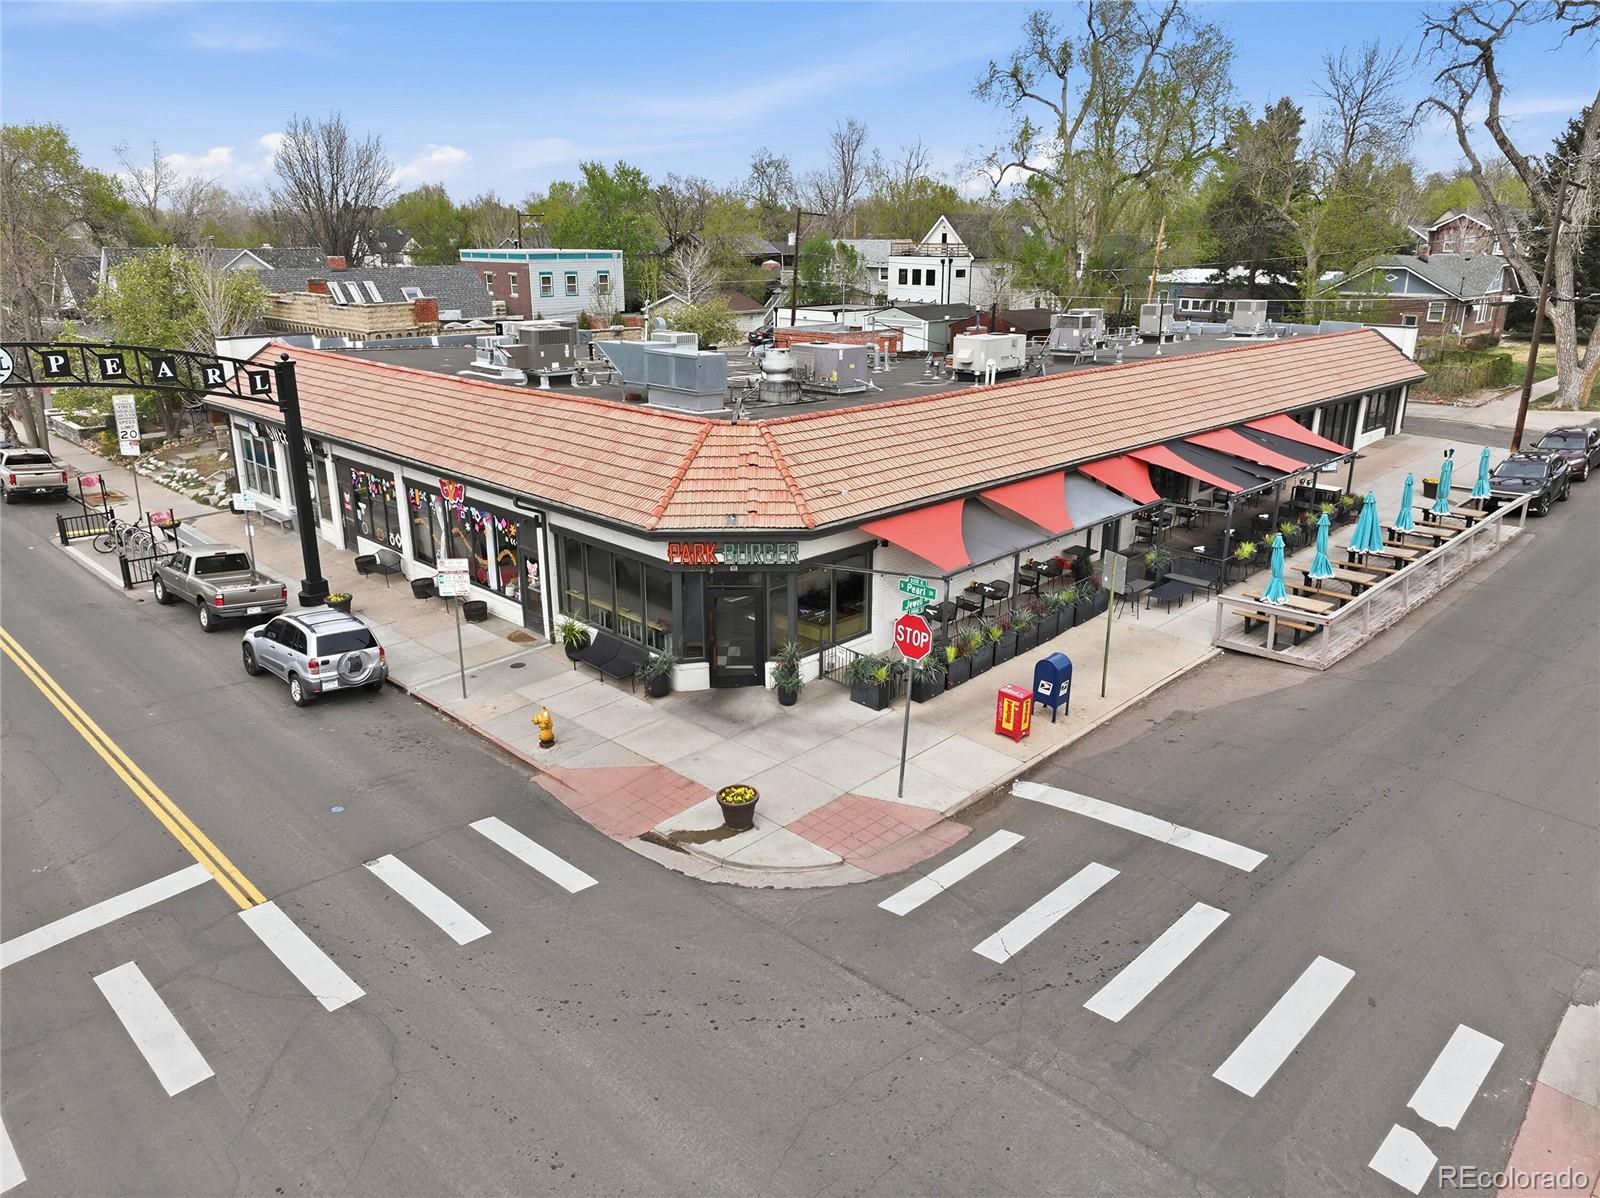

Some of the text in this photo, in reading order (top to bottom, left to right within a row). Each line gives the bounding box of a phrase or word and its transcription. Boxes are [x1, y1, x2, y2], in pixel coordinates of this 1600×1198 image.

[47, 355, 269, 391] PEARL
[120, 430, 138, 439] 20
[667, 542, 800, 565] PARK BURGER
[906, 583, 926, 596] Pearl
[896, 624, 929, 648] STOP
